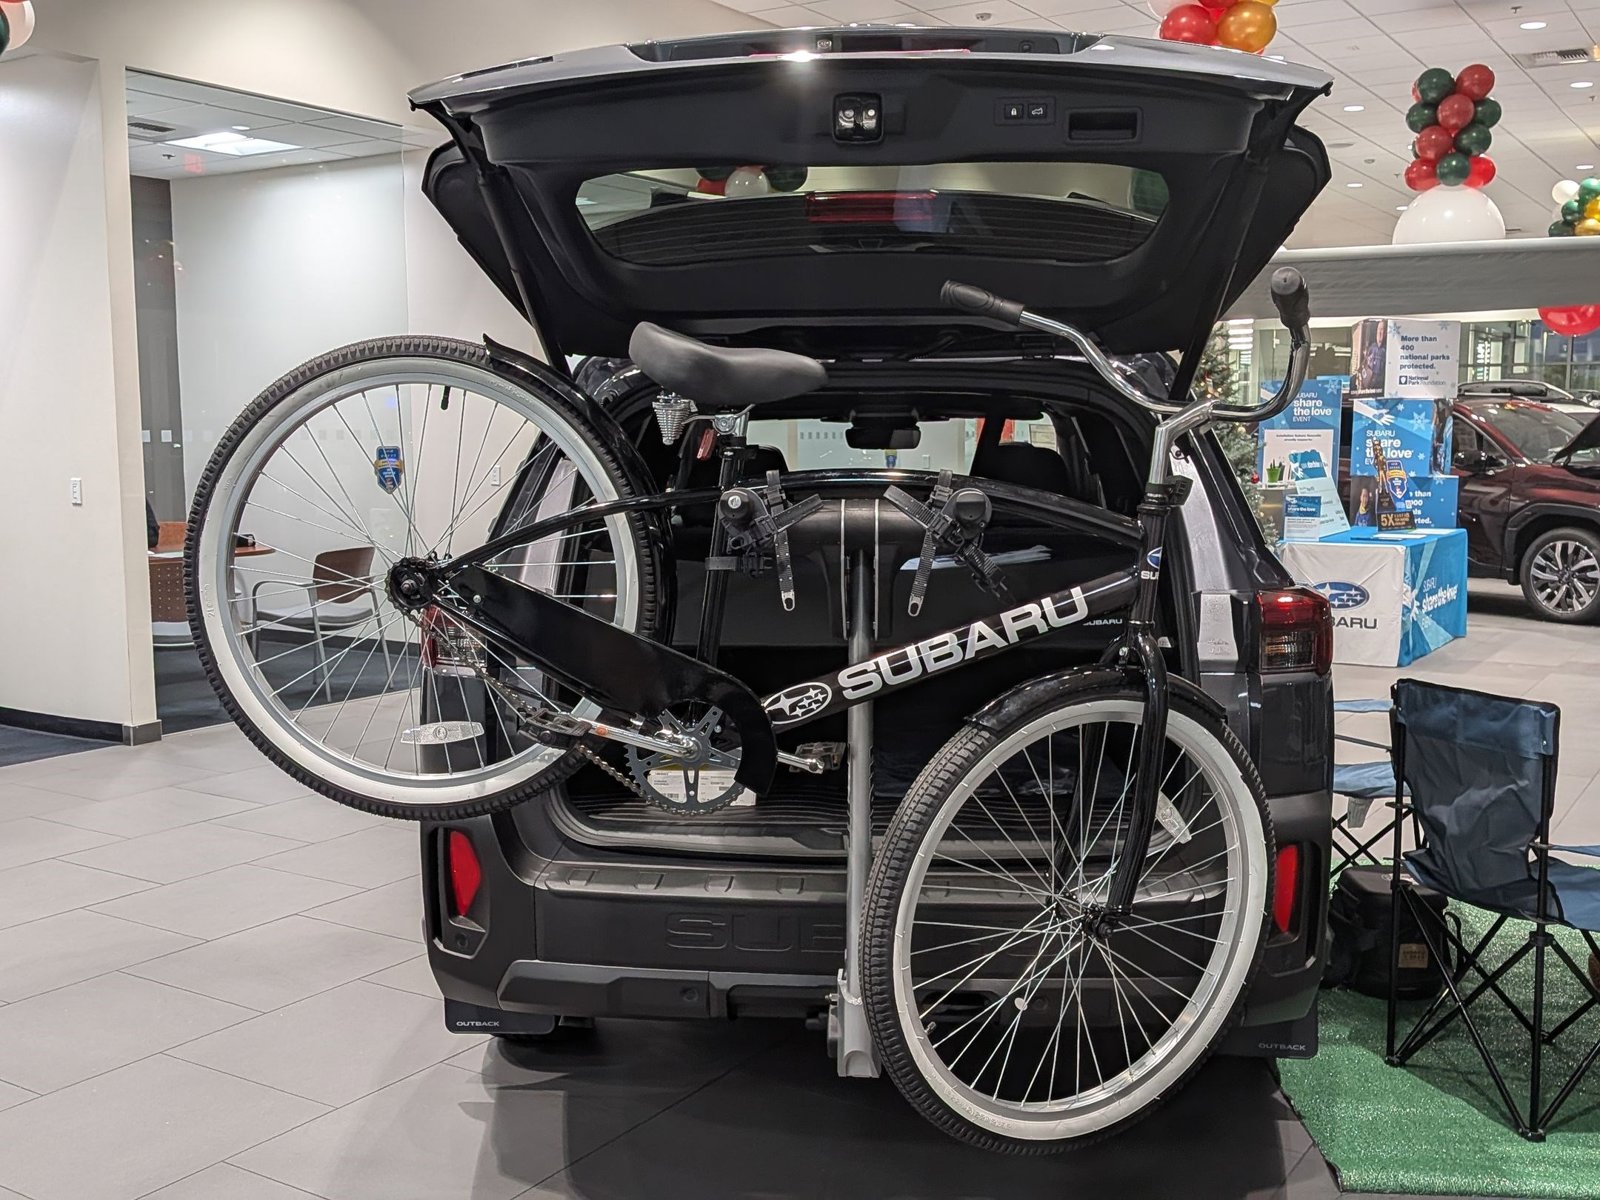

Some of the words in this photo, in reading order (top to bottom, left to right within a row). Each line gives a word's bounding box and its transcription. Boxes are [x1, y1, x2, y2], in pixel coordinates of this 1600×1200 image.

[1430, 353, 1450, 362] parks
[1400, 363, 1436, 371] protected.
[1293, 399, 1323, 407] share
[1293, 407, 1310, 416] the
[1311, 407, 1332, 416] love
[1366, 429, 1395, 437] SUBARU
[1365, 437, 1401, 448] sare
[1387, 447, 1412, 459] love
[1380, 513, 1395, 527] 5X
[838, 586, 1089, 700] SUBARU
[1258, 1042, 1306, 1051] OUTBACK
